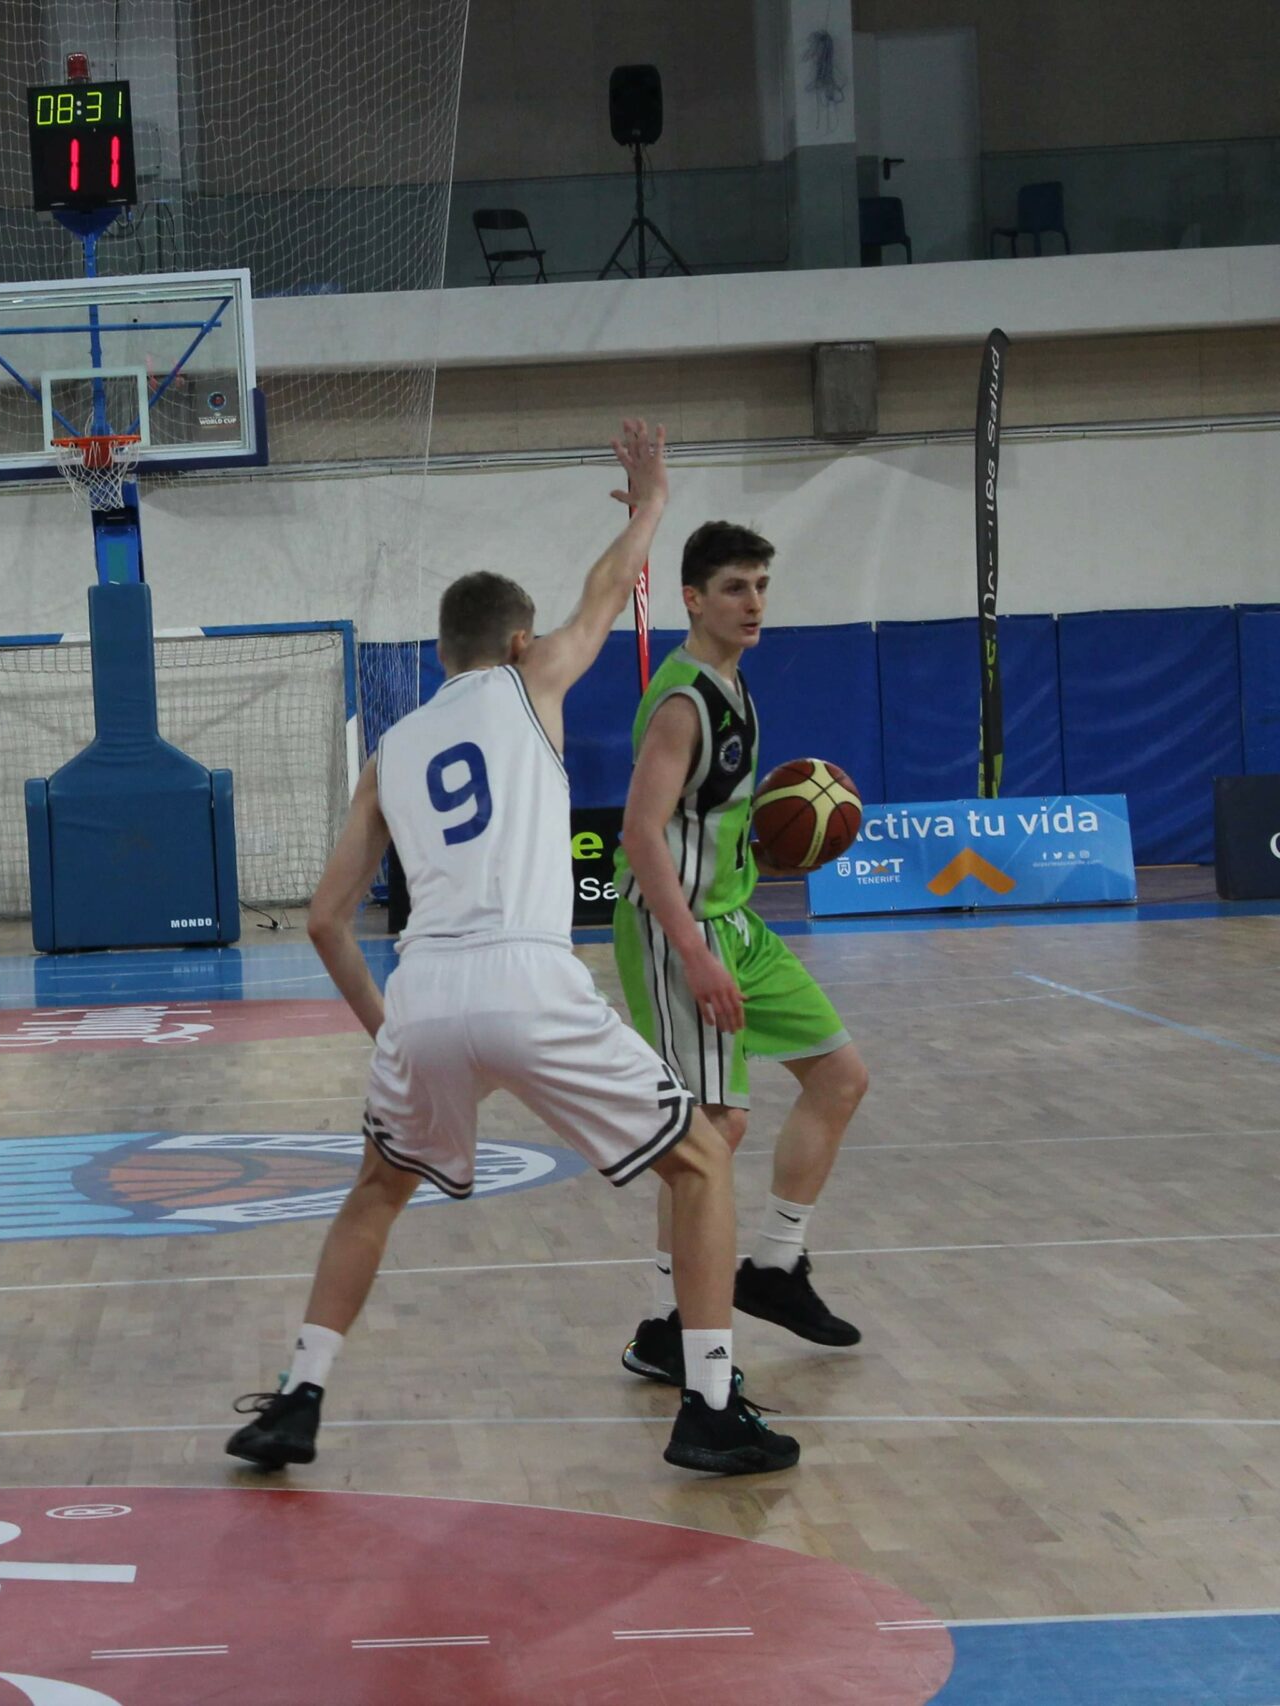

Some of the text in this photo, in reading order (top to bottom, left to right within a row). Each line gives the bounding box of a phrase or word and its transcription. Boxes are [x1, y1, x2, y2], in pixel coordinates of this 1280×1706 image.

[36, 91, 123, 125] 08:31
[426, 741, 493, 845] 9
[855, 803, 1099, 842] ctiva tu vida
[855, 858, 904, 876] DXT
[857, 874, 901, 885] TENERIFE
[170, 918, 212, 928] MONDO
